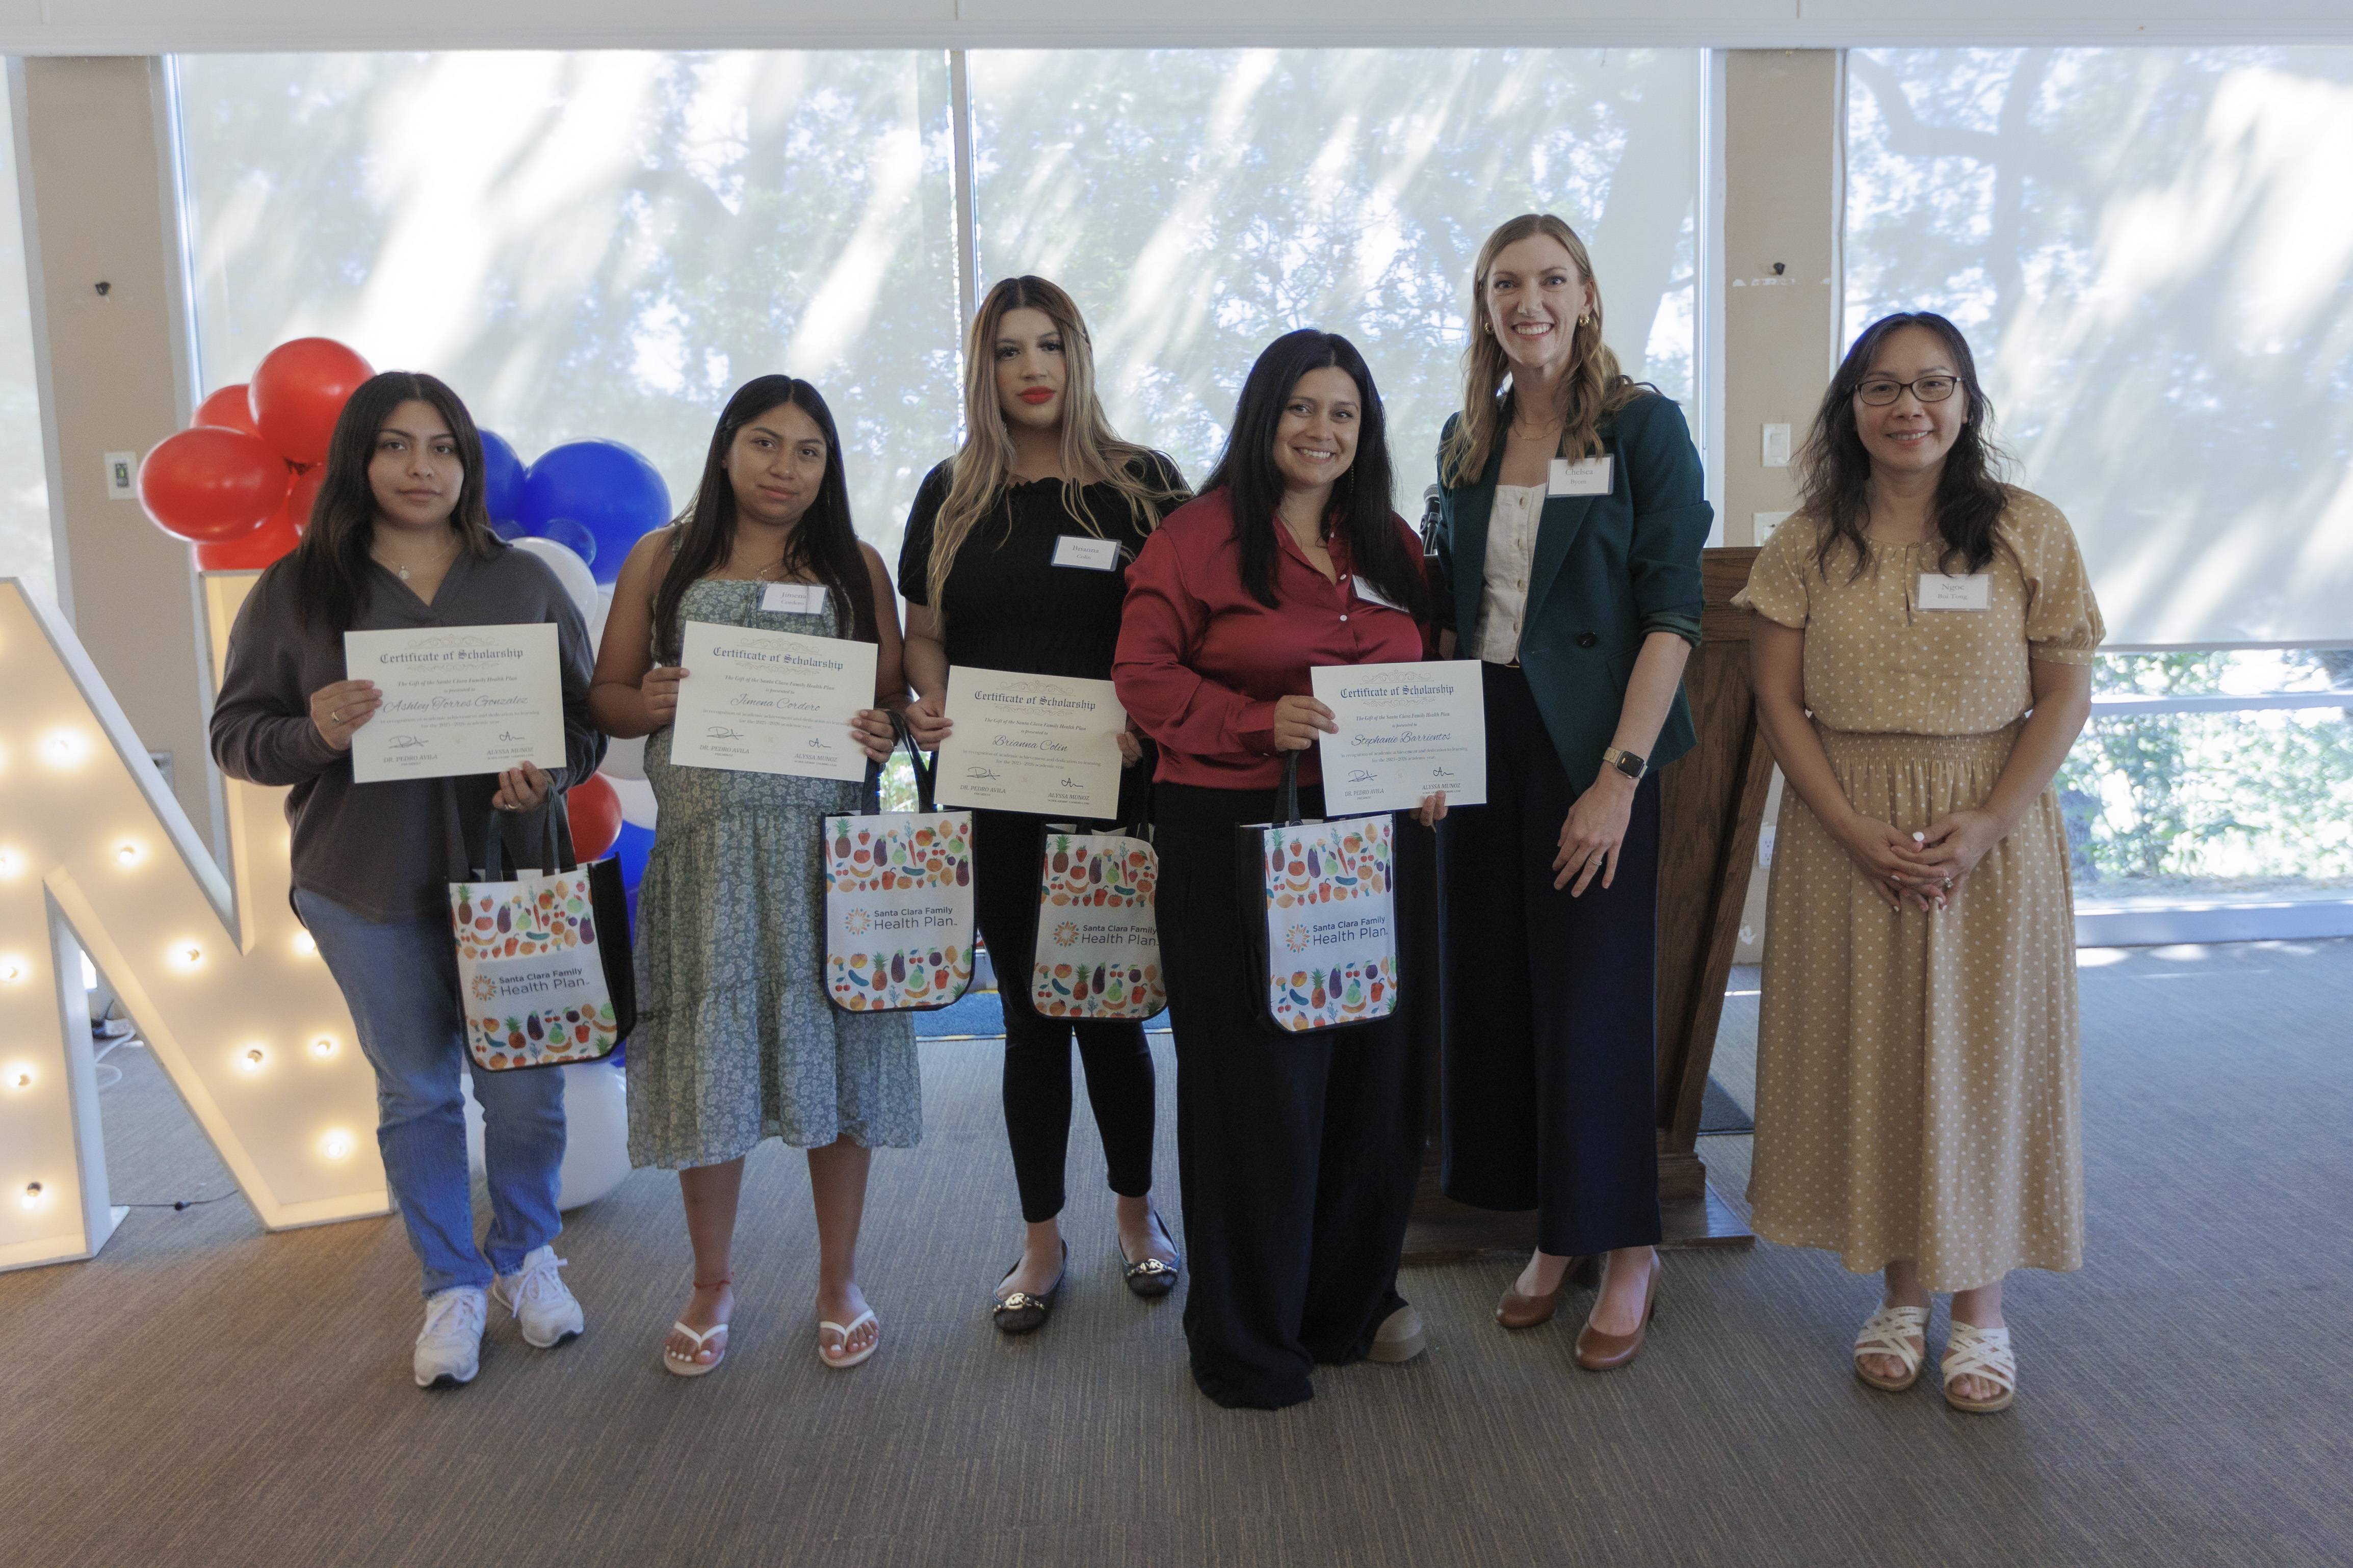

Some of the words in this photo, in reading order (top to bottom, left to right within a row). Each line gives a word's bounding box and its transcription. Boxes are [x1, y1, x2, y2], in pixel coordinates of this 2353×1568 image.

[1072, 545, 1100, 553] Brianna
[1942, 583, 1965, 592] Ngoc
[380, 652, 438, 663] Certificate
[443, 651, 454, 660] of
[458, 648, 523, 659] Scholarship
[713, 646, 766, 661] Certificate
[769, 654, 781, 662] of
[783, 654, 843, 671] Scholarship
[1340, 687, 1388, 698] Certificate
[1390, 686, 1400, 696] of
[1402, 683, 1454, 696] Scholarship
[383, 700, 429, 712] Ashley
[431, 697, 471, 707] Torres
[474, 696, 527, 706] Gonzalez
[730, 693, 773, 706] Jimena
[776, 698, 820, 711] Cordero
[974, 690, 1024, 703] Certificate
[1026, 696, 1036, 704] of
[1039, 696, 1095, 711] Scholarship
[992, 735, 1037, 749] Brianna
[1039, 739, 1067, 752] Colin
[1350, 734, 1398, 747] Stephanie
[1399, 731, 1451, 743] Barrientos
[874, 909, 898, 917] Santa
[925, 906, 953, 915] Family
[874, 917, 919, 931] Health
[1130, 925, 1157, 934] Family
[1313, 923, 1335, 932] Santa
[1338, 920, 1358, 928] Clara
[1361, 915, 1385, 925] Family
[1081, 934, 1123, 944] Health
[1313, 927, 1355, 946] Health
[499, 975, 525, 984] Santa
[527, 972, 551, 980] Clara
[553, 968, 583, 977] Family
[501, 980, 548, 997] Health
